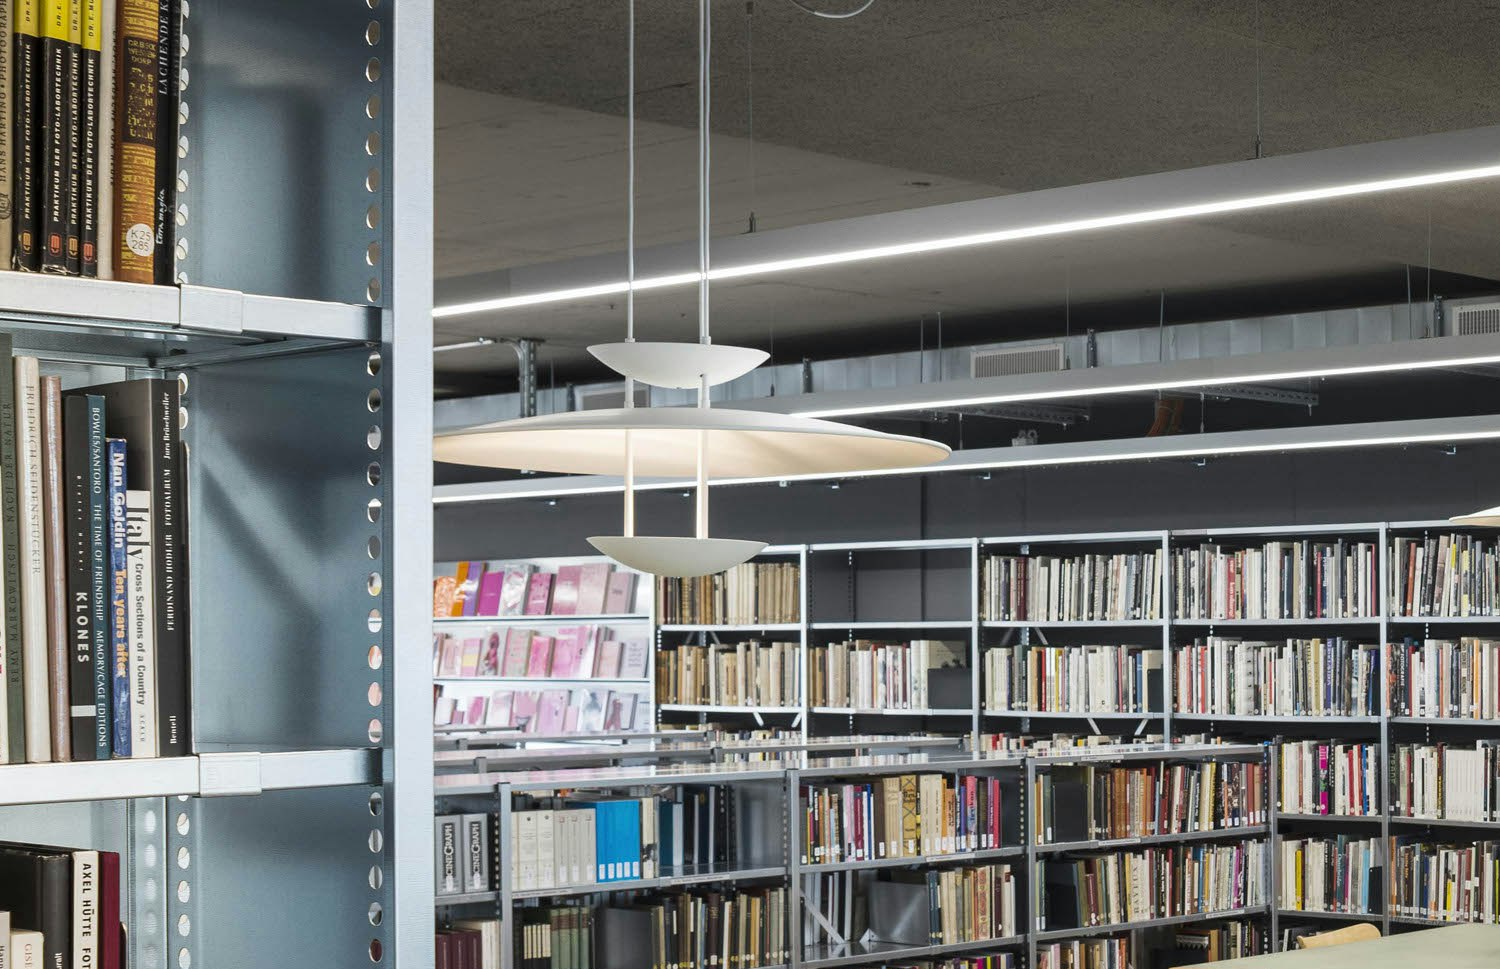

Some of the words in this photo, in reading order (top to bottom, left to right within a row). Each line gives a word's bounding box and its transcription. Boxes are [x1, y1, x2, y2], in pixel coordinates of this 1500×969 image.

[54, 48, 62, 145] FOTO-LABORTECHNIK
[86, 58, 94, 153] FOTO-LABORTECHNIK
[92, 407, 101, 494] BOWLES/SANTORO
[113, 453, 124, 486] Nan
[94, 525, 102, 548] TIME
[114, 493, 125, 548] Goldin
[95, 549, 103, 563] OF
[96, 566, 104, 621] FRIENDSHIP
[116, 570, 127, 594] Ten
[76, 592, 90, 663] KLONES
[114, 599, 125, 639] years
[96, 630, 105, 700] MEMORY/CAGE
[117, 643, 128, 678] after
[99, 703, 107, 747] EDITIONS
[83, 863, 91, 893] AXEL
[83, 900, 95, 937] HÜTTE
